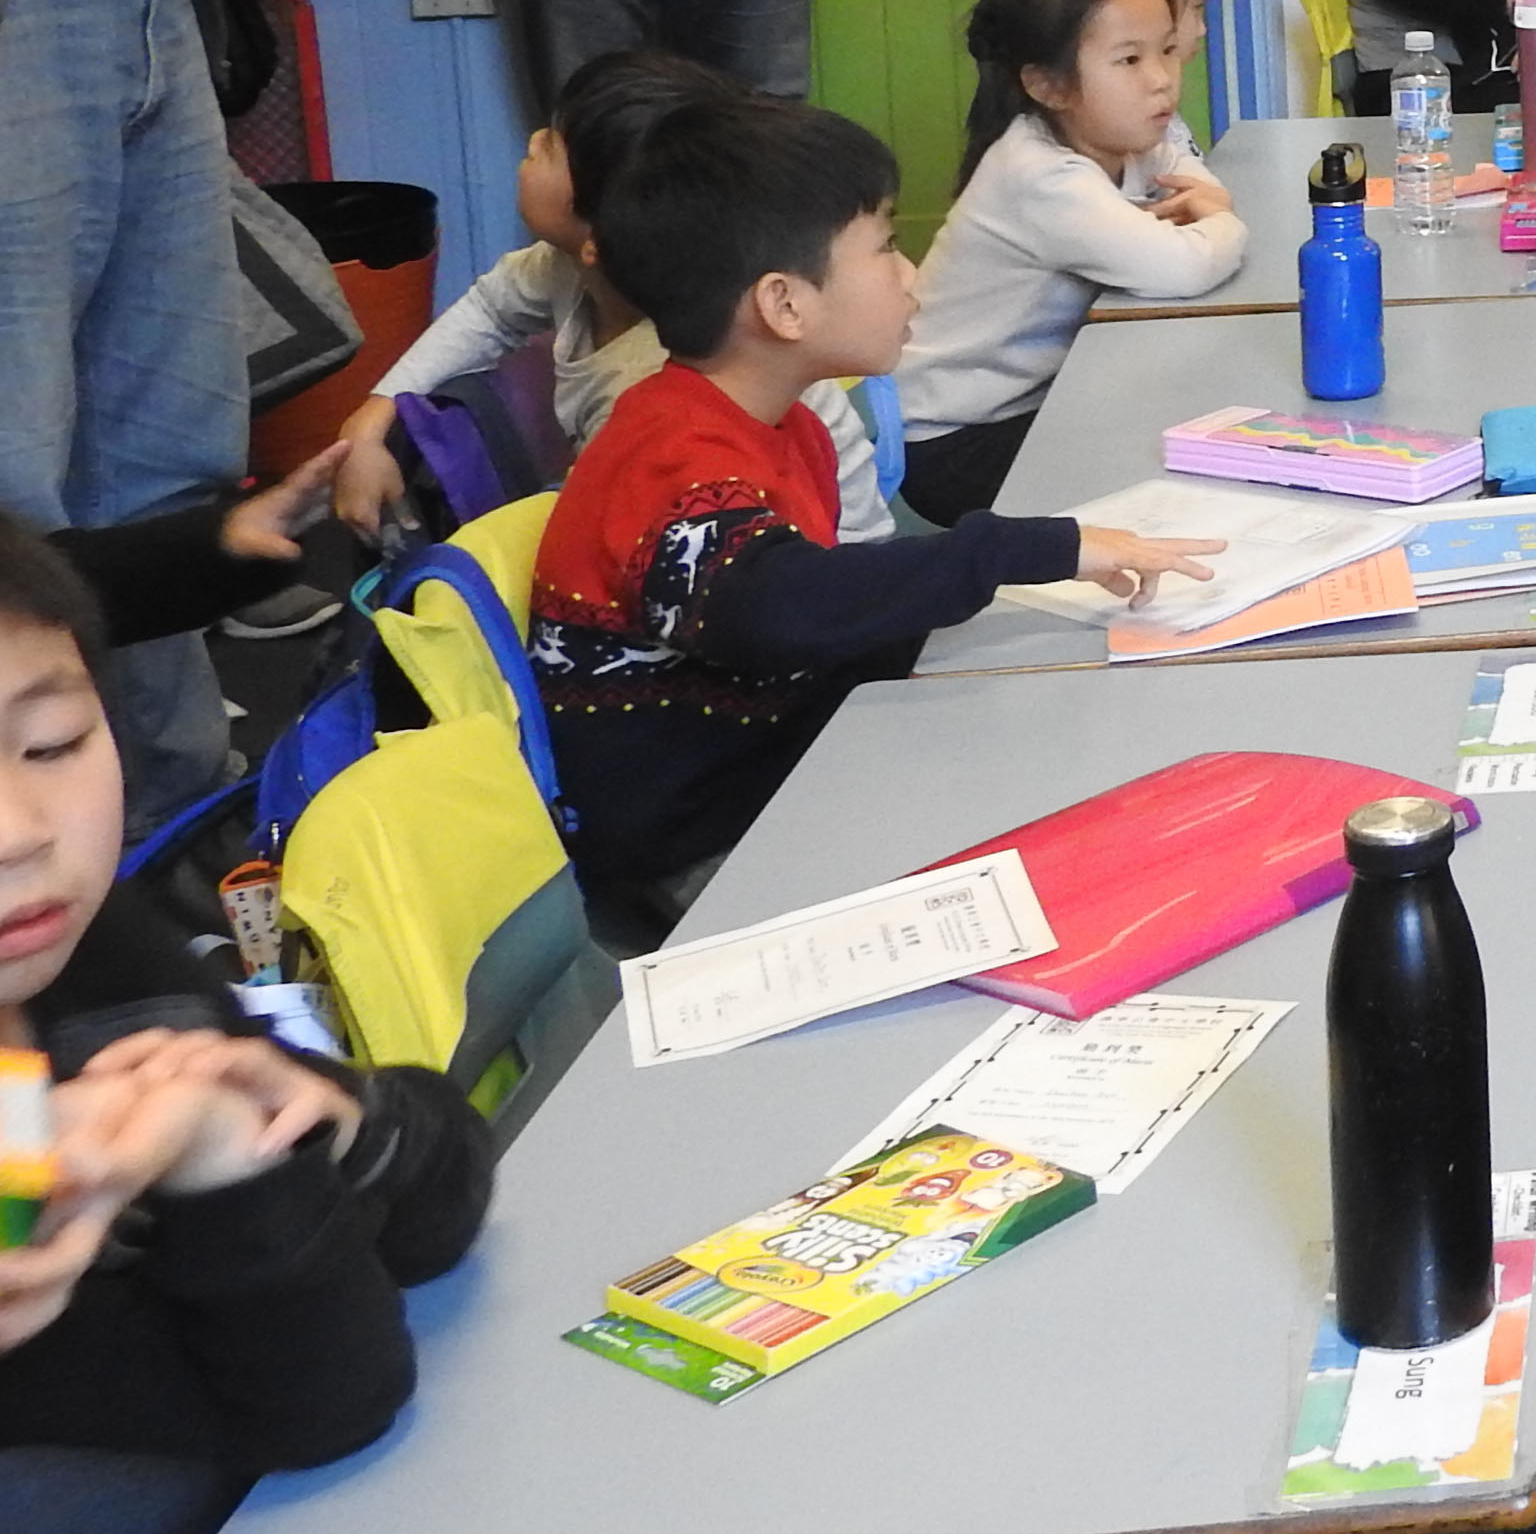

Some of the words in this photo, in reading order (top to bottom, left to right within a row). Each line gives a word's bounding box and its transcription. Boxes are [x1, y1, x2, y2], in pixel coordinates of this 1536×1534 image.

[978, 1152, 1008, 1168] 10
[767, 1227, 877, 1274] Silly
[735, 1265, 805, 1288] Crayola
[710, 1372, 738, 1393] 10
[1395, 1356, 1435, 1399] Sung
